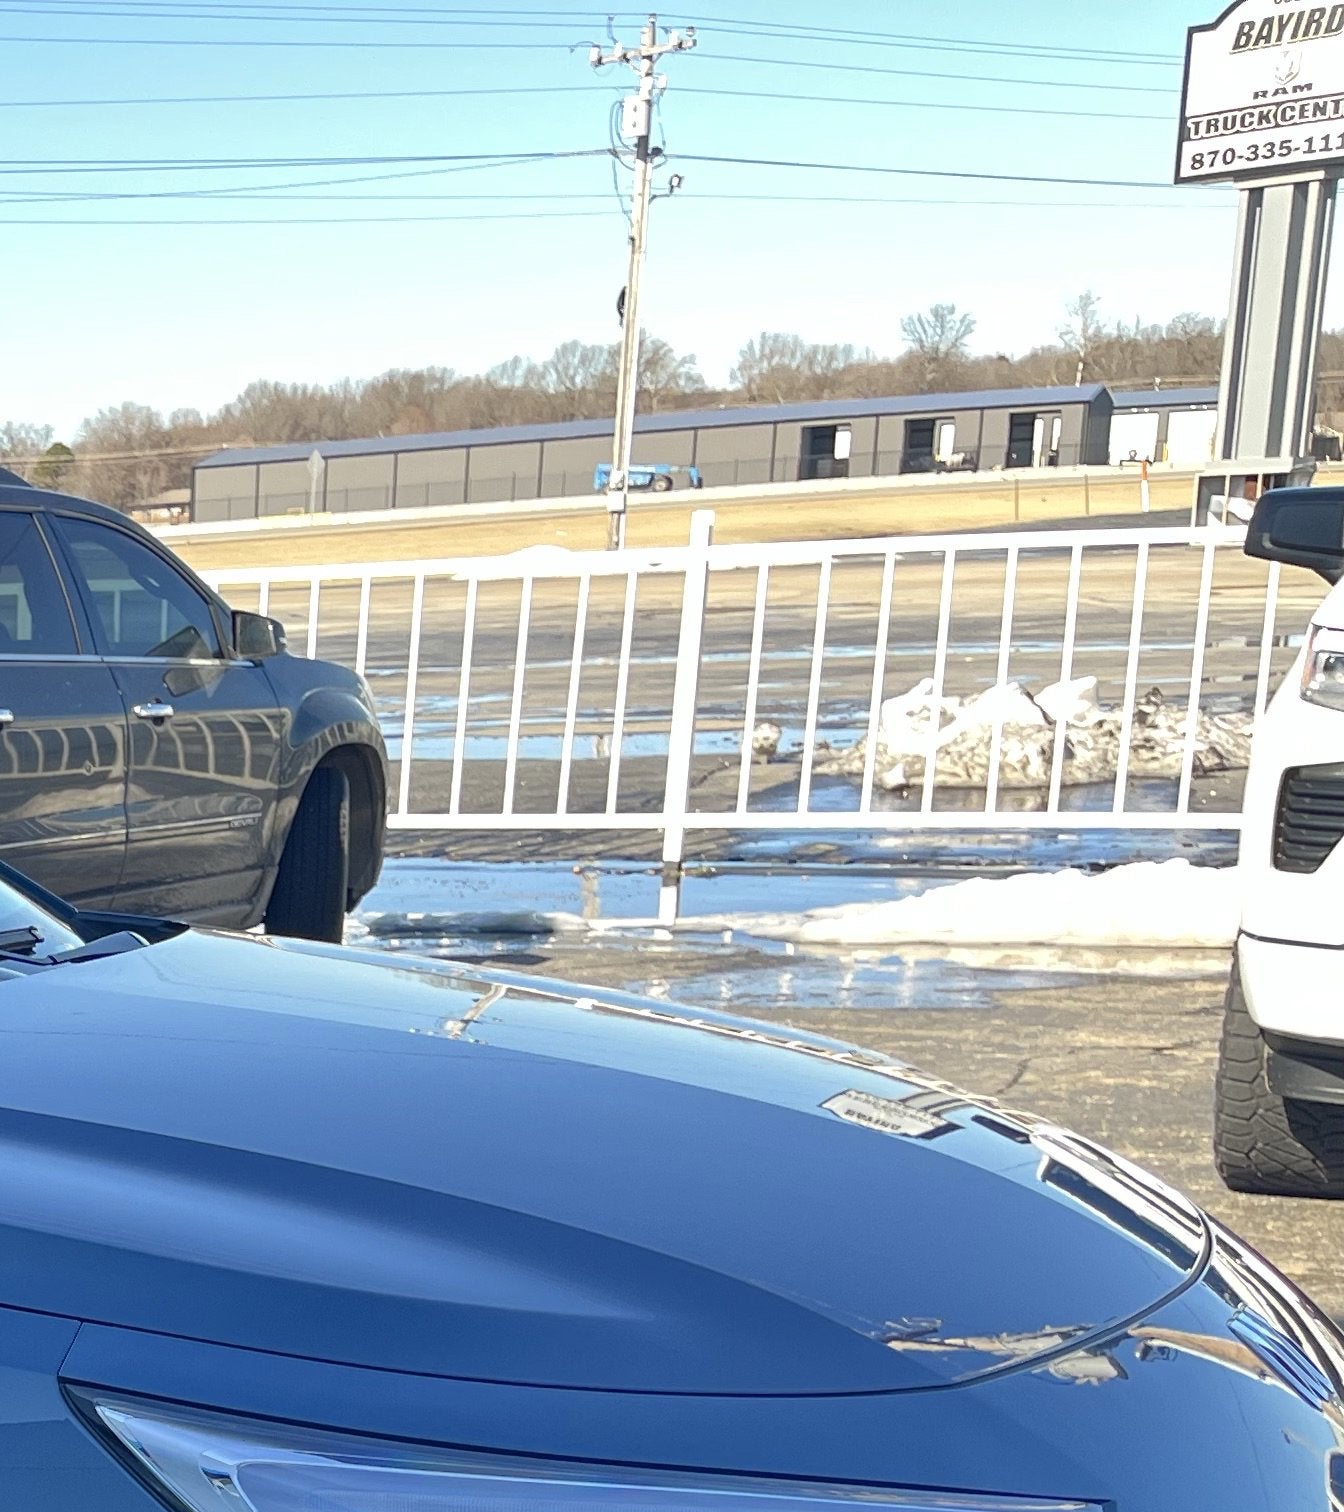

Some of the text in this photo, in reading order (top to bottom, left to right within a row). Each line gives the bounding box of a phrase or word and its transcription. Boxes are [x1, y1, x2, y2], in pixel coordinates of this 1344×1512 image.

[1232, 4, 1344, 51] BAYIRD
[1253, 83, 1313, 100] RAM
[1191, 108, 1273, 137] TRUCK
